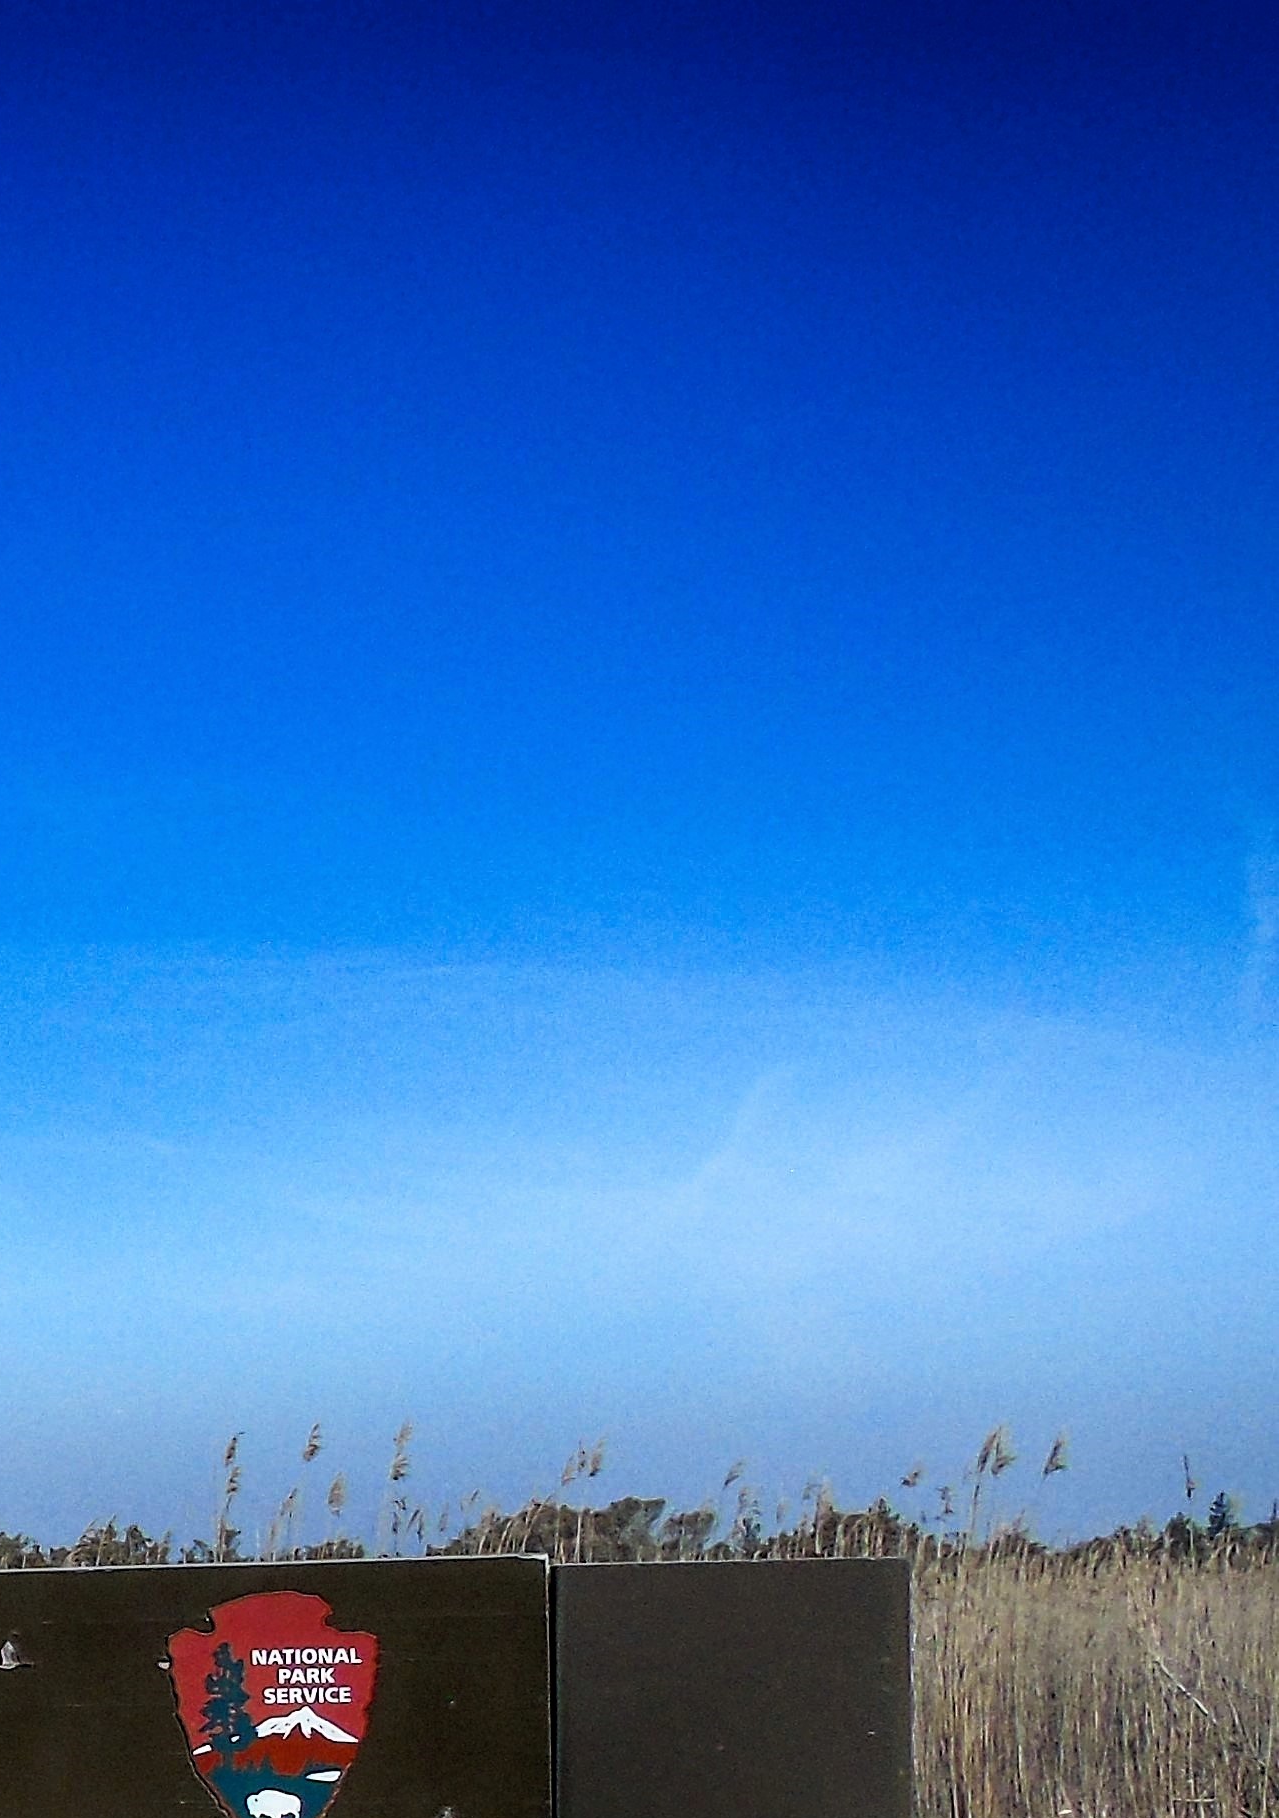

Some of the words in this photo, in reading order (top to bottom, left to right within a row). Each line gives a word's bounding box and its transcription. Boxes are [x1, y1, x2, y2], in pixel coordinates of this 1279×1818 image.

[252, 1648, 363, 1665] NATIONAL
[279, 1668, 336, 1685] PARK
[264, 1687, 352, 1704] SERVICE
